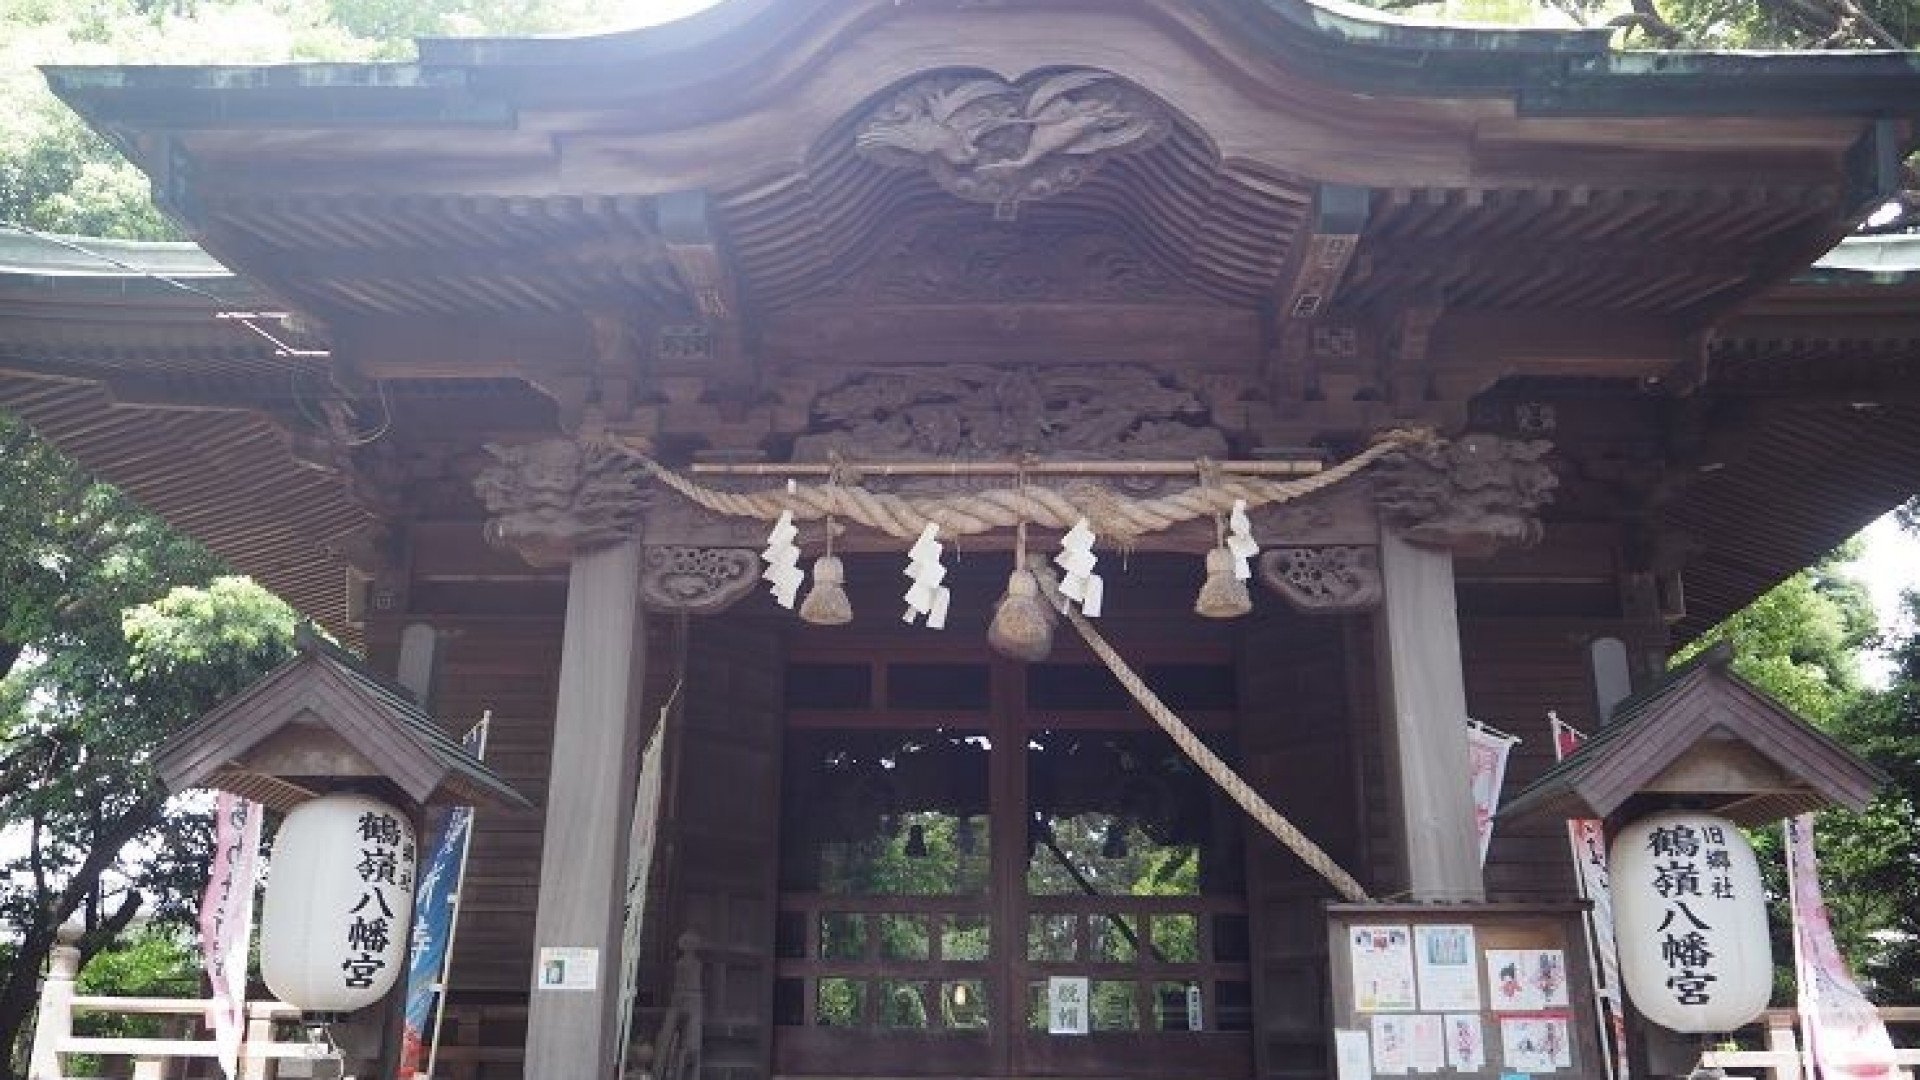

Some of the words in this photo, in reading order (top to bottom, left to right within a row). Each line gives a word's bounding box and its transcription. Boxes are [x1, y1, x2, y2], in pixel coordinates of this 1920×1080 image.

[341, 811, 401, 989] 鶴嶺八幡宮
[1648, 825, 1717, 1006] 鶴嶺八幡宮
